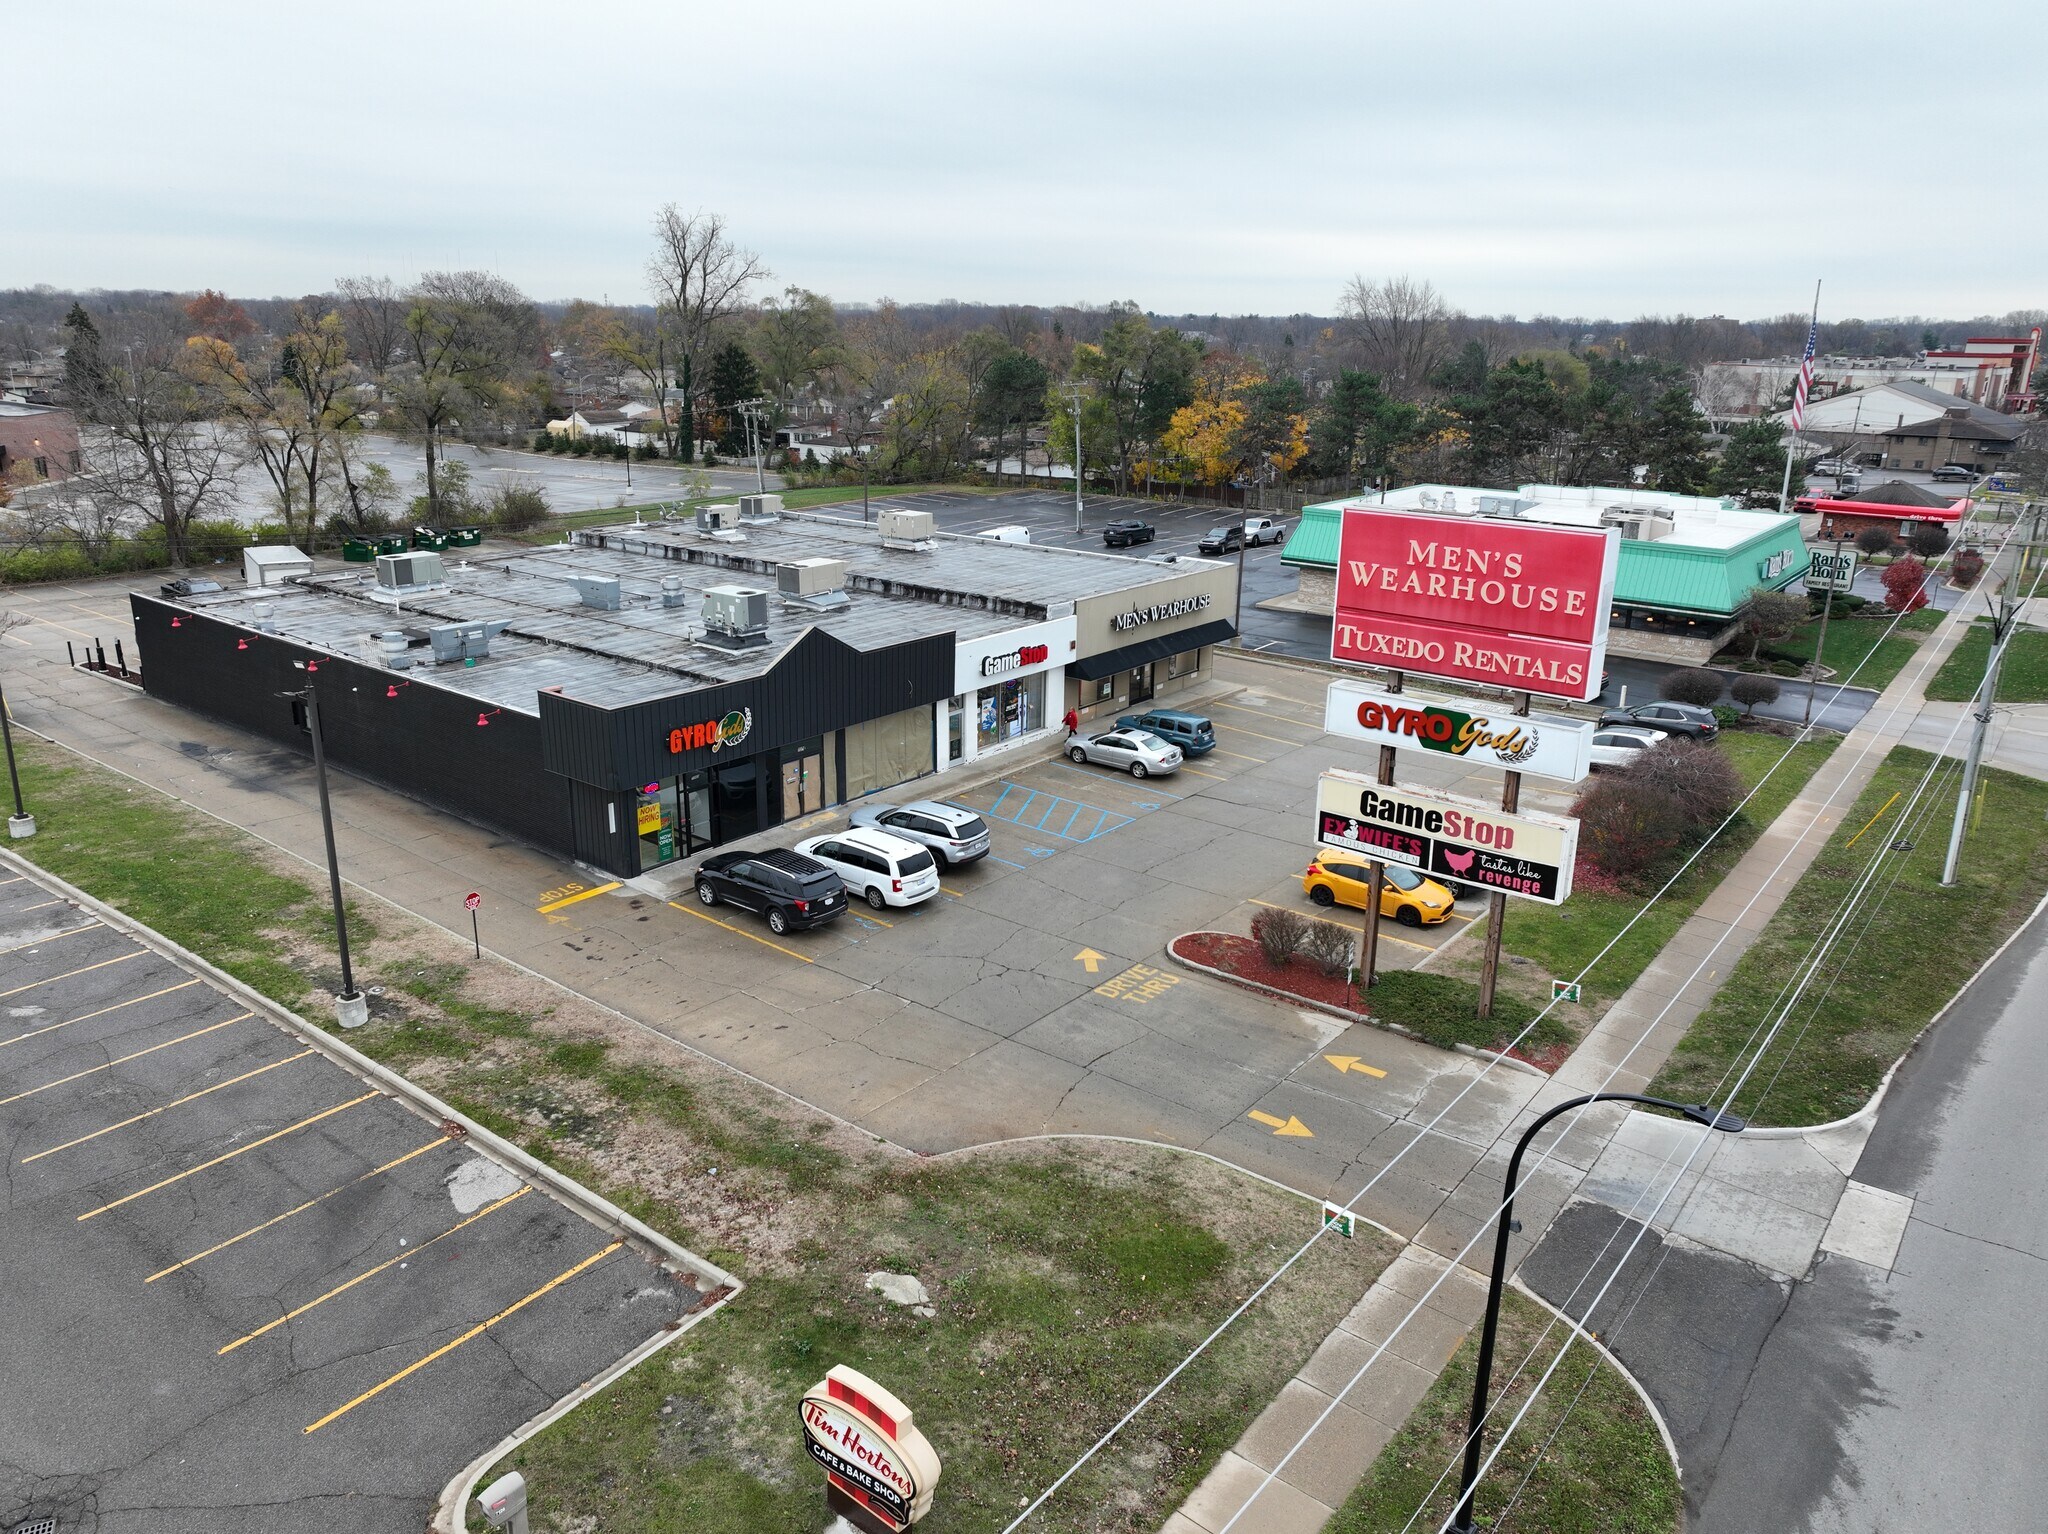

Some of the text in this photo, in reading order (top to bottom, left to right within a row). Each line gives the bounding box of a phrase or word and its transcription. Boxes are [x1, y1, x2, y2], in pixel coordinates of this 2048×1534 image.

[1406, 539, 1523, 579] MEN'S
[1348, 560, 1587, 617] WEARHOUSE
[1114, 593, 1211, 632] MEN'S WEARHOUSE
[981, 644, 1048, 677] GameStop
[1337, 624, 1583, 685] TUXEDO RENTALS
[670, 720, 717, 754] GYRO
[1357, 701, 1528, 754] GYRO Gods
[639, 812, 660, 825] HIRING
[640, 804, 657, 816] NOW
[1360, 790, 1514, 850] GameStop
[660, 838, 673, 846] OPEN
[1324, 817, 1422, 857] EX WIFE'S
[1325, 833, 1419, 864] FAMOUS CHICKEN
[1478, 869, 1541, 894] revenge
[1479, 854, 1542, 879] tastes like
[465, 896, 480, 908] STOP
[540, 882, 584, 903] STOP
[1093, 963, 1159, 998] DRIVE
[1121, 972, 1182, 1004] THRU
[804, 1399, 840, 1441] Tim
[842, 1426, 912, 1495] Hortons
[813, 1444, 901, 1504] CAFE & BAKE SHOP
